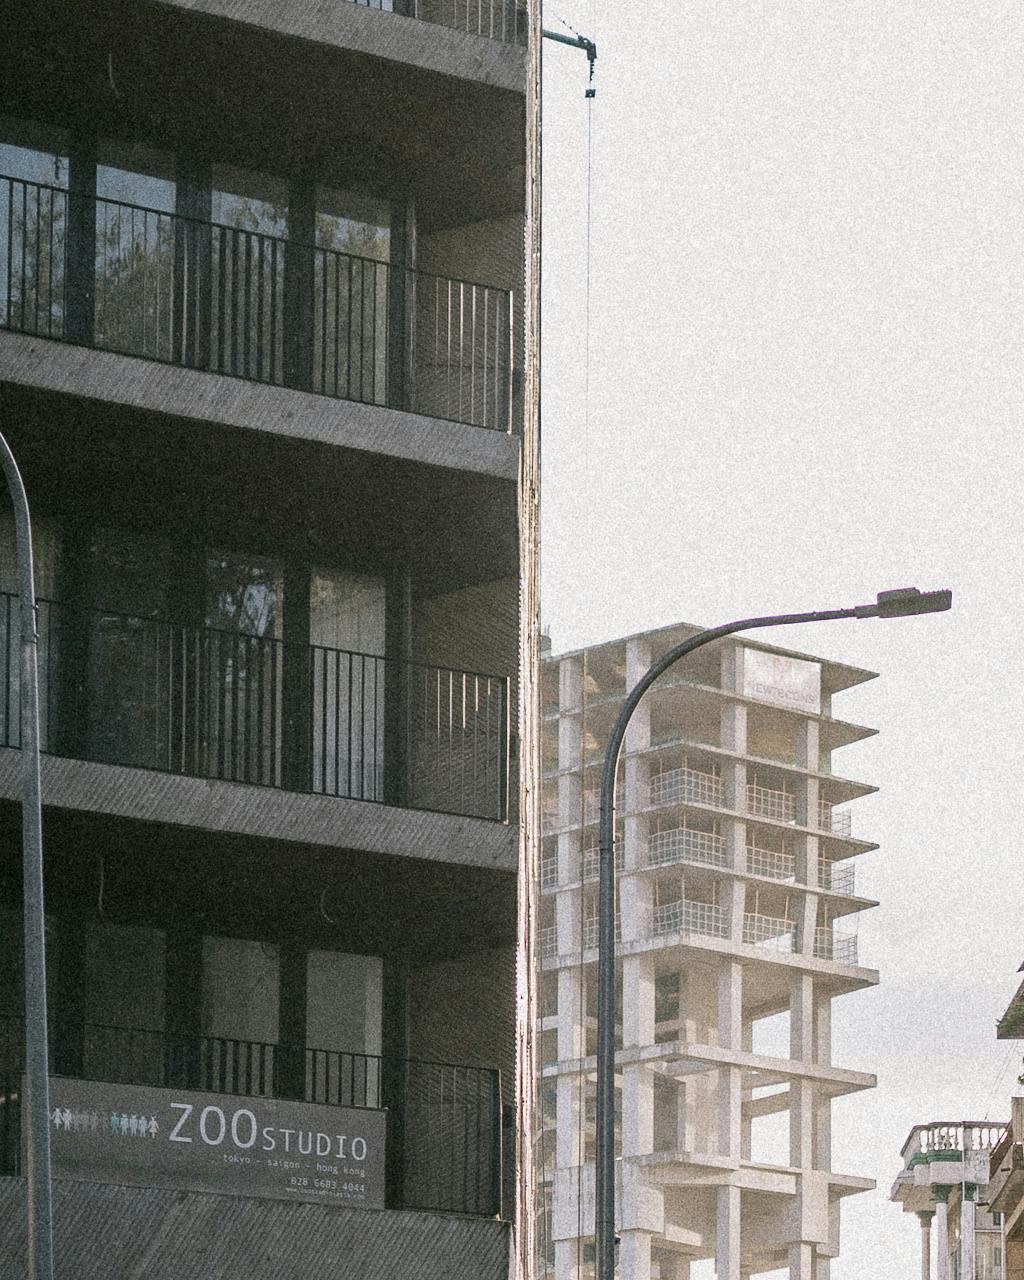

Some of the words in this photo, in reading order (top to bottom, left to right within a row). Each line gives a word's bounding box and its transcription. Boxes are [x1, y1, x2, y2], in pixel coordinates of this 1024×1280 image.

[224, 1154, 250, 1165] tokyo
[267, 1159, 300, 1169] saigon
[316, 1163, 338, 1175] hong
[344, 1167, 365, 1178] kong
